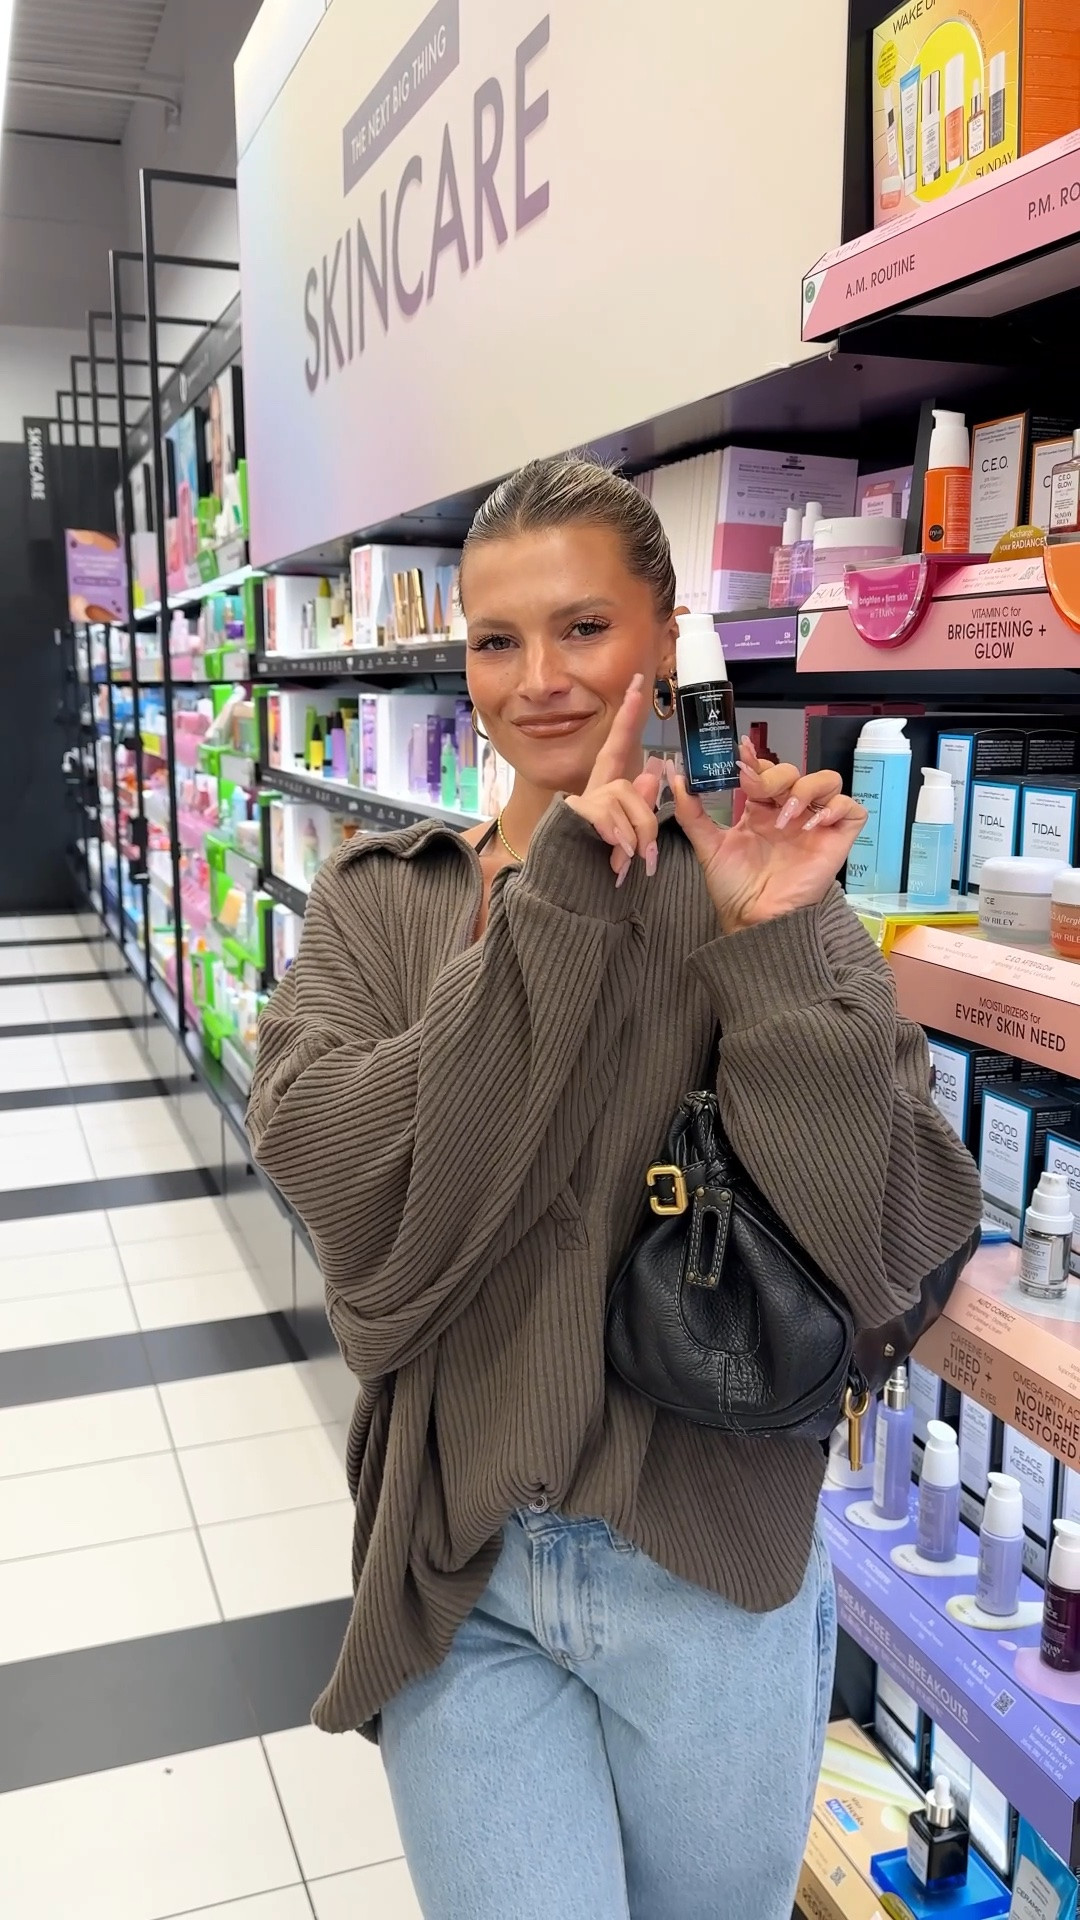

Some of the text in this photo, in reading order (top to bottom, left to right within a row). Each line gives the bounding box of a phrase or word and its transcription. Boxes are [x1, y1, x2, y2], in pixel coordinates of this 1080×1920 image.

[892, 0, 923, 35] WAKE
[351, 24, 447, 165] THE NEXT BIG THING
[304, 13, 550, 393] SKINCARE
[1028, 193, 1055, 221] P.M.
[845, 254, 916, 300] A.M. ROUTINE
[27, 427, 46, 501] SKINCARE
[981, 455, 1009, 473] C.E.O.
[1011, 537, 1045, 550] RADIANCE
[896, 592, 909, 601] skin
[971, 605, 1021, 619] VITAMIN C for
[947, 620, 1047, 640] BRIGHTENING +
[974, 641, 1015, 659] GLOW
[702, 760, 735, 771] SUNDAY
[709, 768, 732, 777] RILEY
[978, 813, 1006, 828] TIDAL
[1031, 822, 1062, 837] TIDAL
[991, 917, 1015, 926] RILEY
[979, 996, 1041, 1025] MOISTURIZERS for
[955, 1003, 1066, 1053] EVERY SKIN NEED
[991, 1118, 1018, 1138] GOOD
[988, 1131, 1019, 1153] GENES
[977, 1298, 1017, 1323] AUTO CORRECT
[950, 1331, 983, 1358] CAFFEINE
[949, 1343, 993, 1383] TIRED +
[943, 1358, 997, 1407] PUFFY EYES
[1012, 1370, 1044, 1398] OMEGA
[1044, 1390, 1067, 1411] FATTY
[1014, 1406, 1077, 1460] RESTORED
[1009, 1456, 1045, 1488] KEEPER
[1013, 1446, 1043, 1474] PEACE
[837, 1583, 867, 1621] BREAK
[869, 1615, 893, 1647] FREE
[908, 1654, 969, 1725] BREAKOUTS
